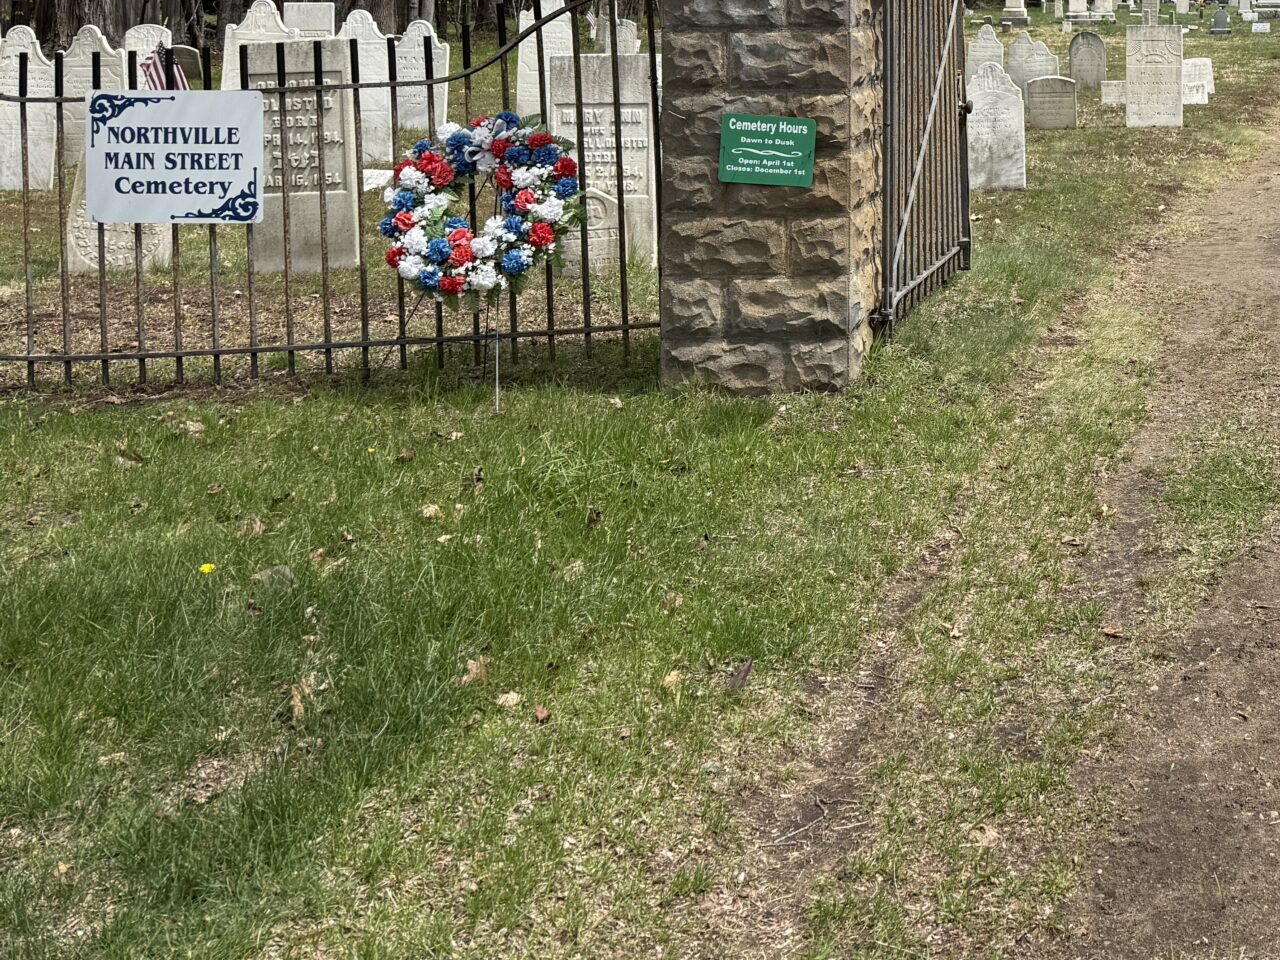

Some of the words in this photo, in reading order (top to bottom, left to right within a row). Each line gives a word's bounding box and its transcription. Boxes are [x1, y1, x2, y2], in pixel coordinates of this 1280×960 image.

[561, 108, 604, 124] MRY
[729, 118, 776, 135] Cemetery
[779, 121, 808, 134] Hours
[107, 126, 240, 144] NORTHVILLE
[740, 136, 762, 144] Dawn
[775, 138, 795, 146] Dusk
[104, 152, 155, 170] MAIN
[164, 152, 243, 170] STREET
[738, 157, 760, 166] Open:
[762, 158, 780, 167] April
[782, 159, 794, 167] 1st
[754, 166, 792, 175] December
[794, 168, 805, 176] 1st
[114, 176, 232, 199] Cemetery
